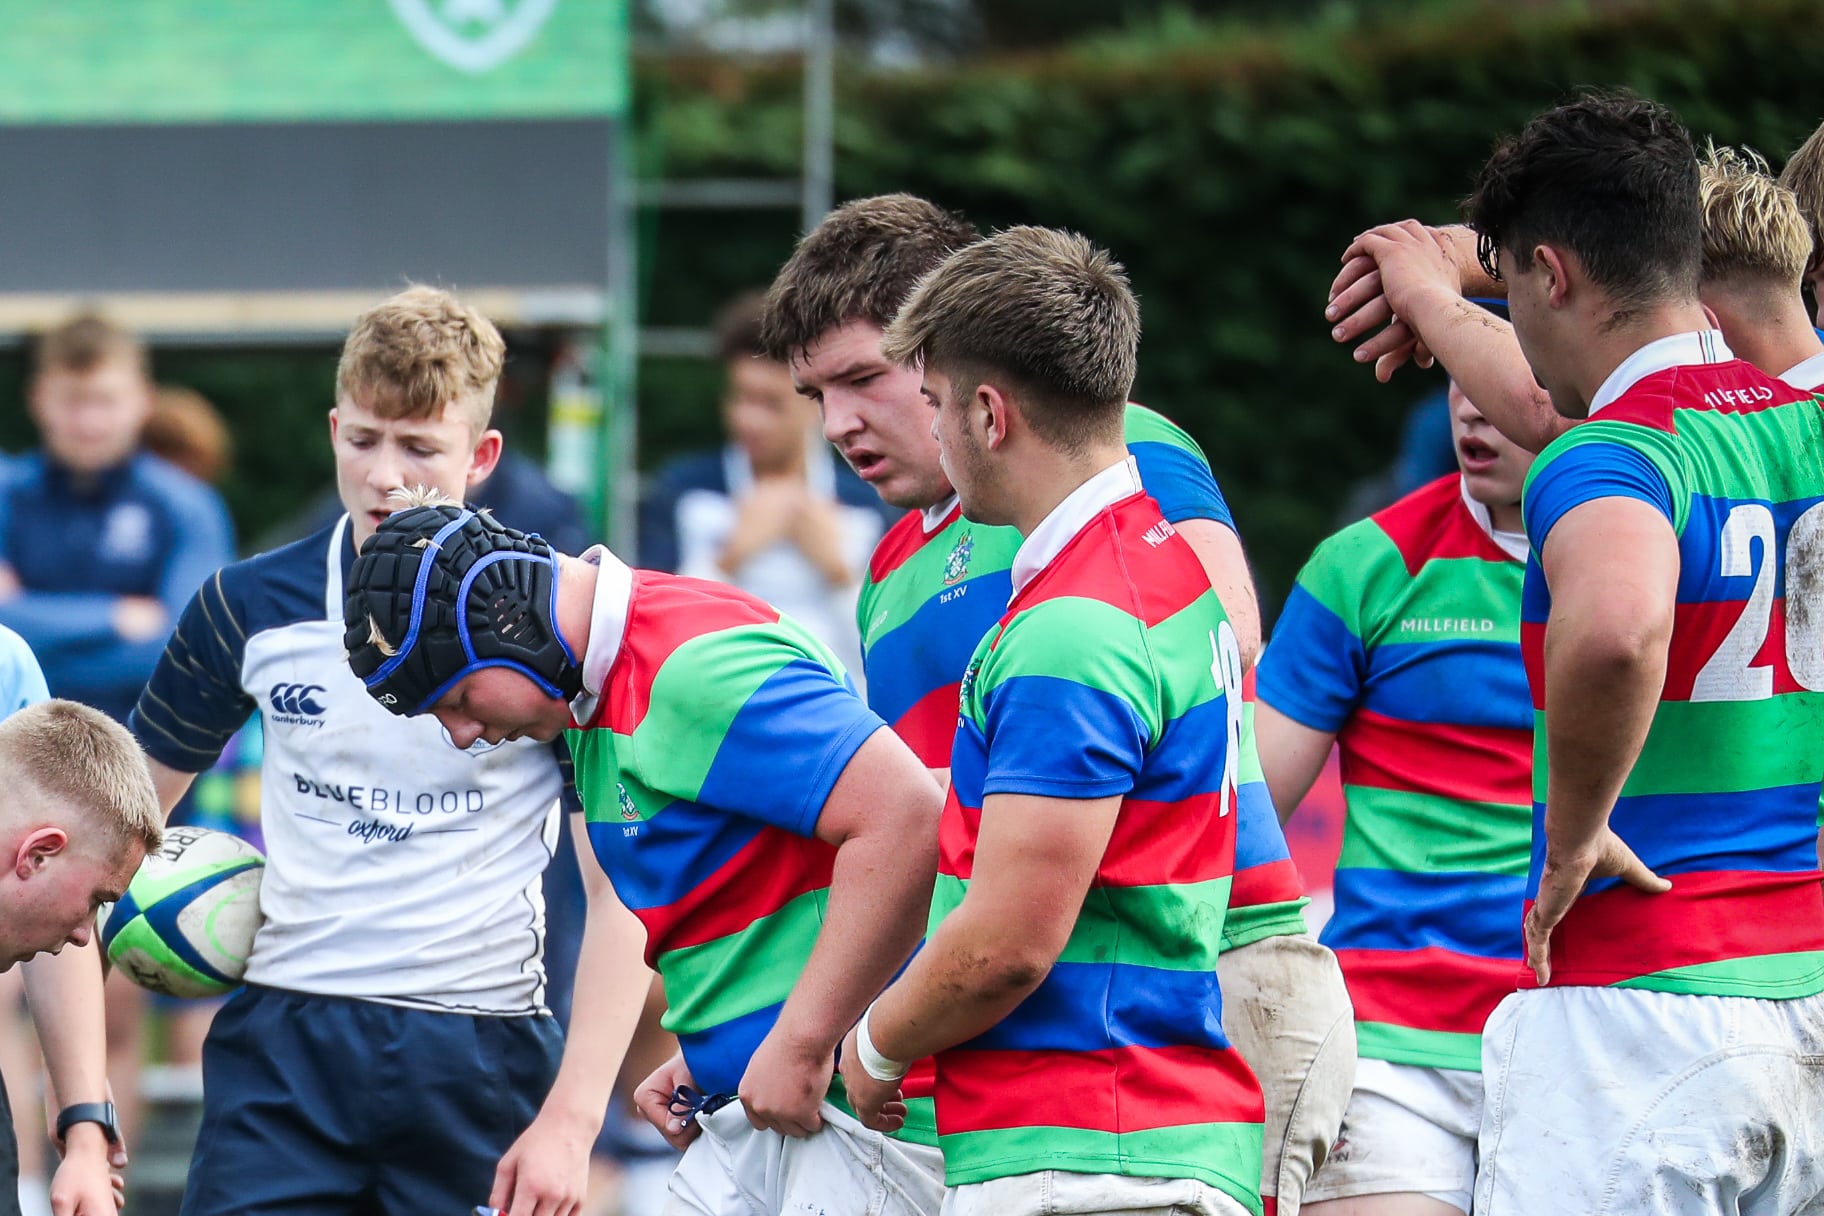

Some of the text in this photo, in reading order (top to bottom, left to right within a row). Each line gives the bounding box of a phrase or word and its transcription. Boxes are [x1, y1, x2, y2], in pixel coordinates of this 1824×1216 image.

[939, 585, 968, 604] 1st XV
[1400, 618, 1494, 633] MILLFIELD
[271, 714, 326, 729] canterbury
[348, 819, 415, 844] oxford
